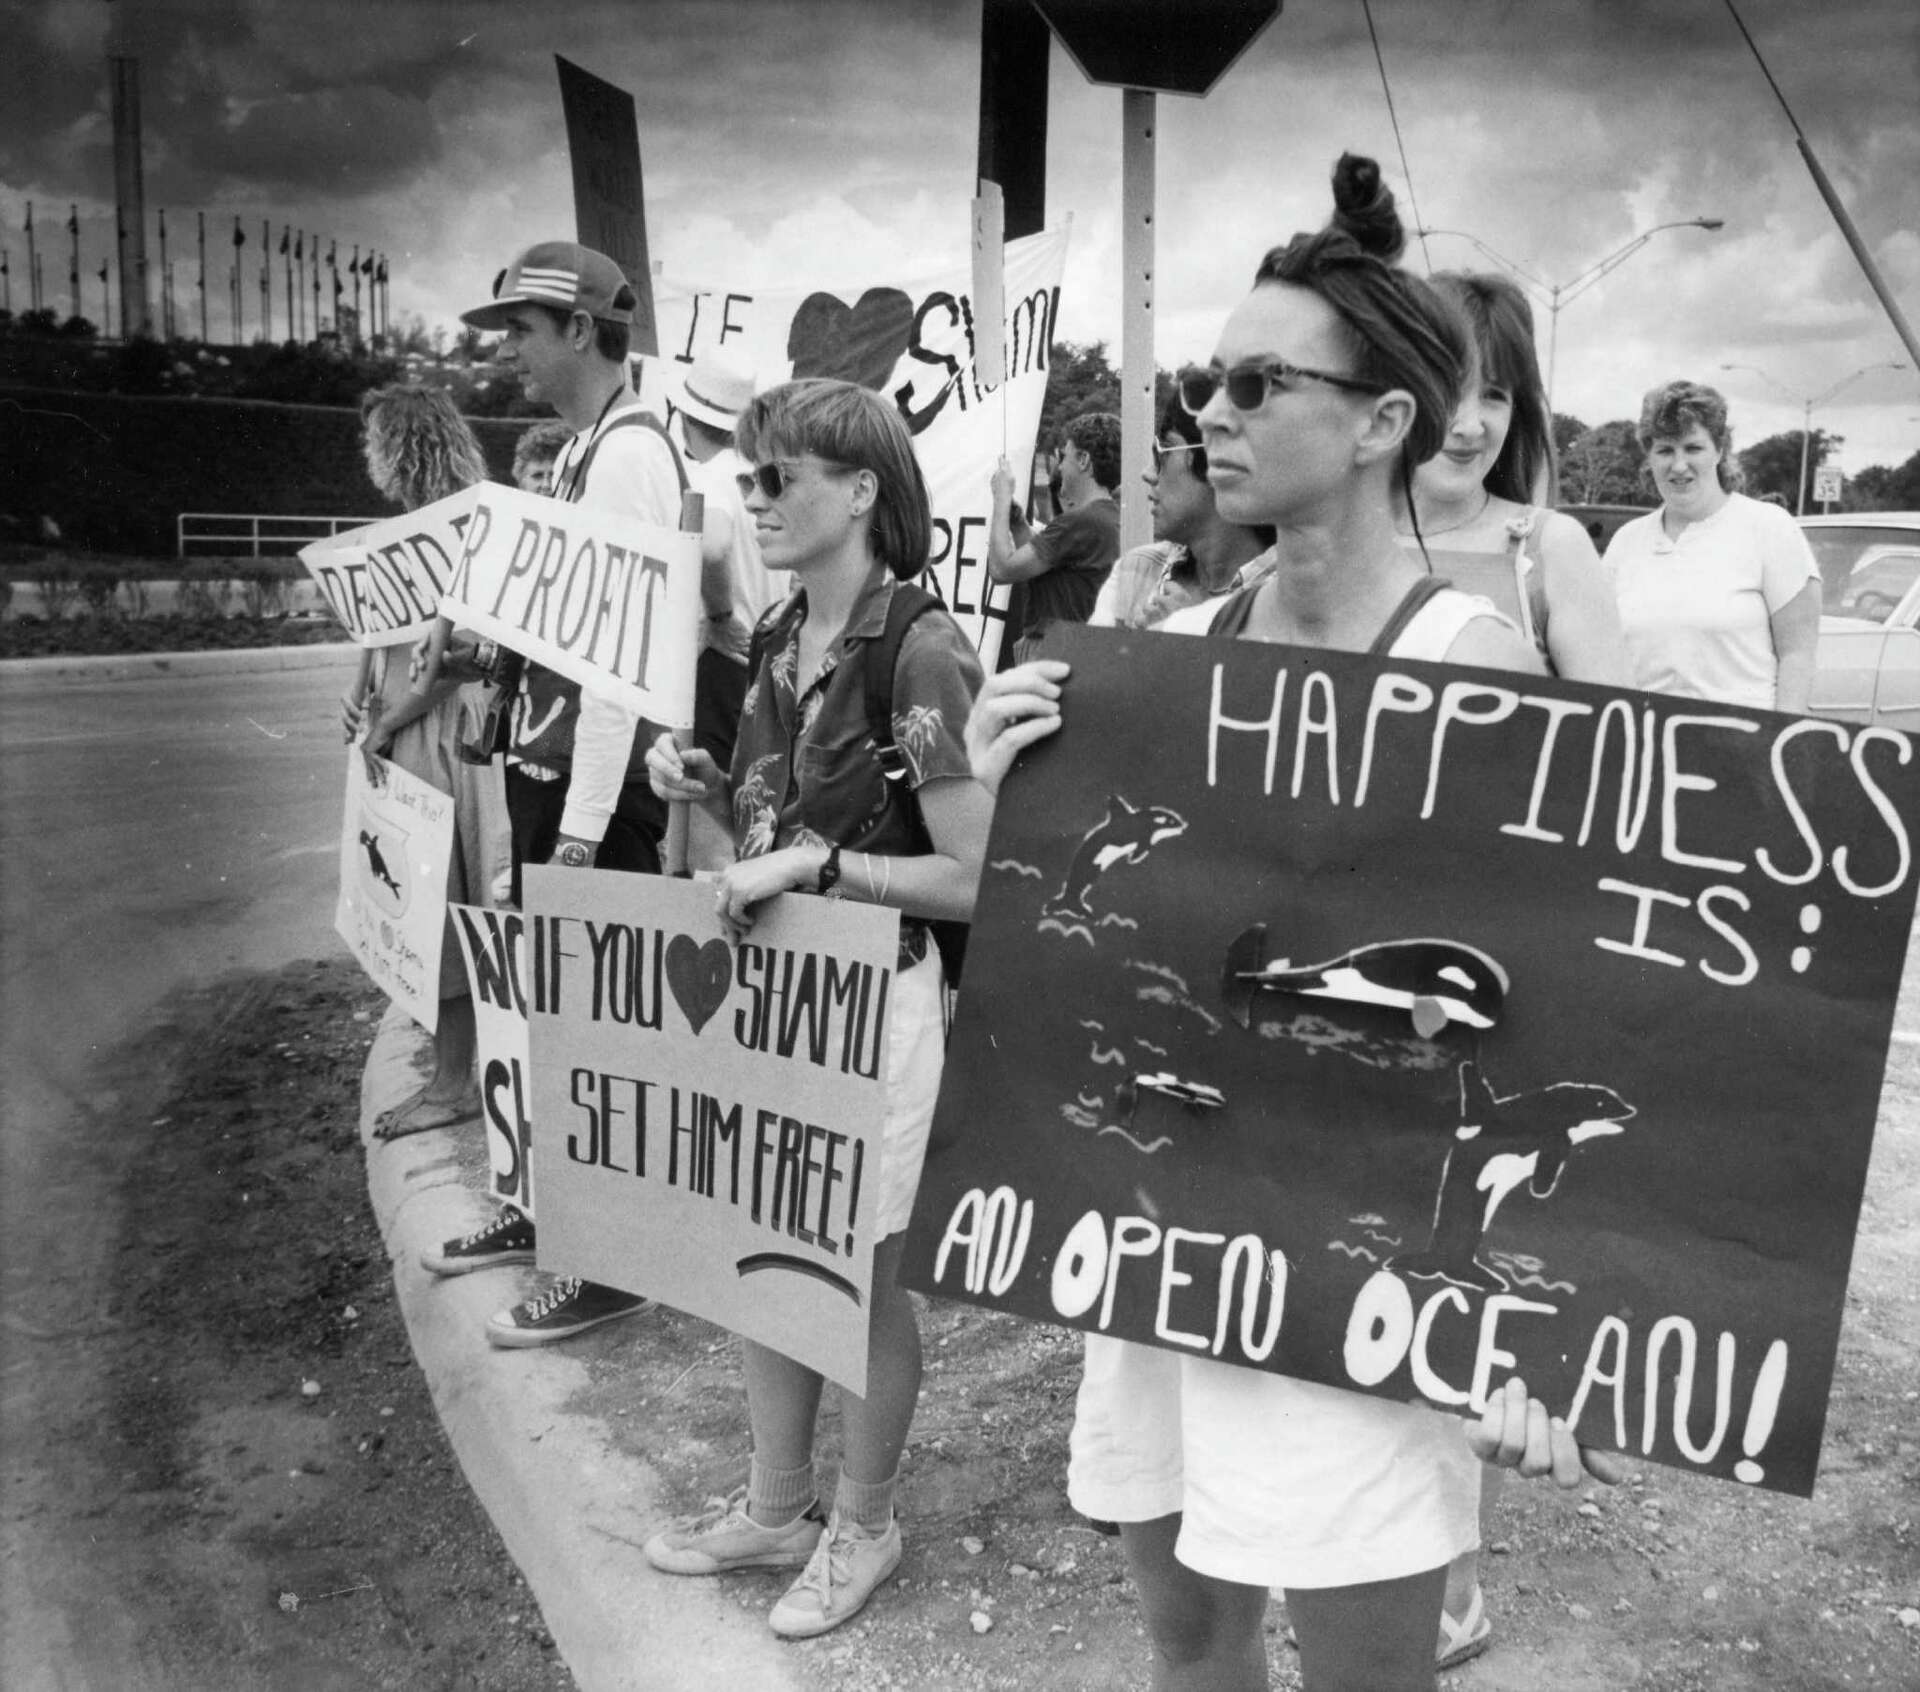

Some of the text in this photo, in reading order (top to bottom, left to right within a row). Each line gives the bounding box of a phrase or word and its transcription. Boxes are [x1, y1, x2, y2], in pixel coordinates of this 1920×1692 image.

[674, 292, 753, 363] IF
[488, 517, 669, 692] PROFIT
[1207, 663, 1912, 897] HAPPINESS
[533, 914, 581, 1015] IF
[584, 919, 665, 1031] YOU
[734, 943, 889, 1080] SHAMU
[1594, 877, 1822, 986] IS:
[567, 1067, 864, 1257] SET HIM FREE!
[934, 1185, 1787, 1483] AN OPEN OCEAN!
